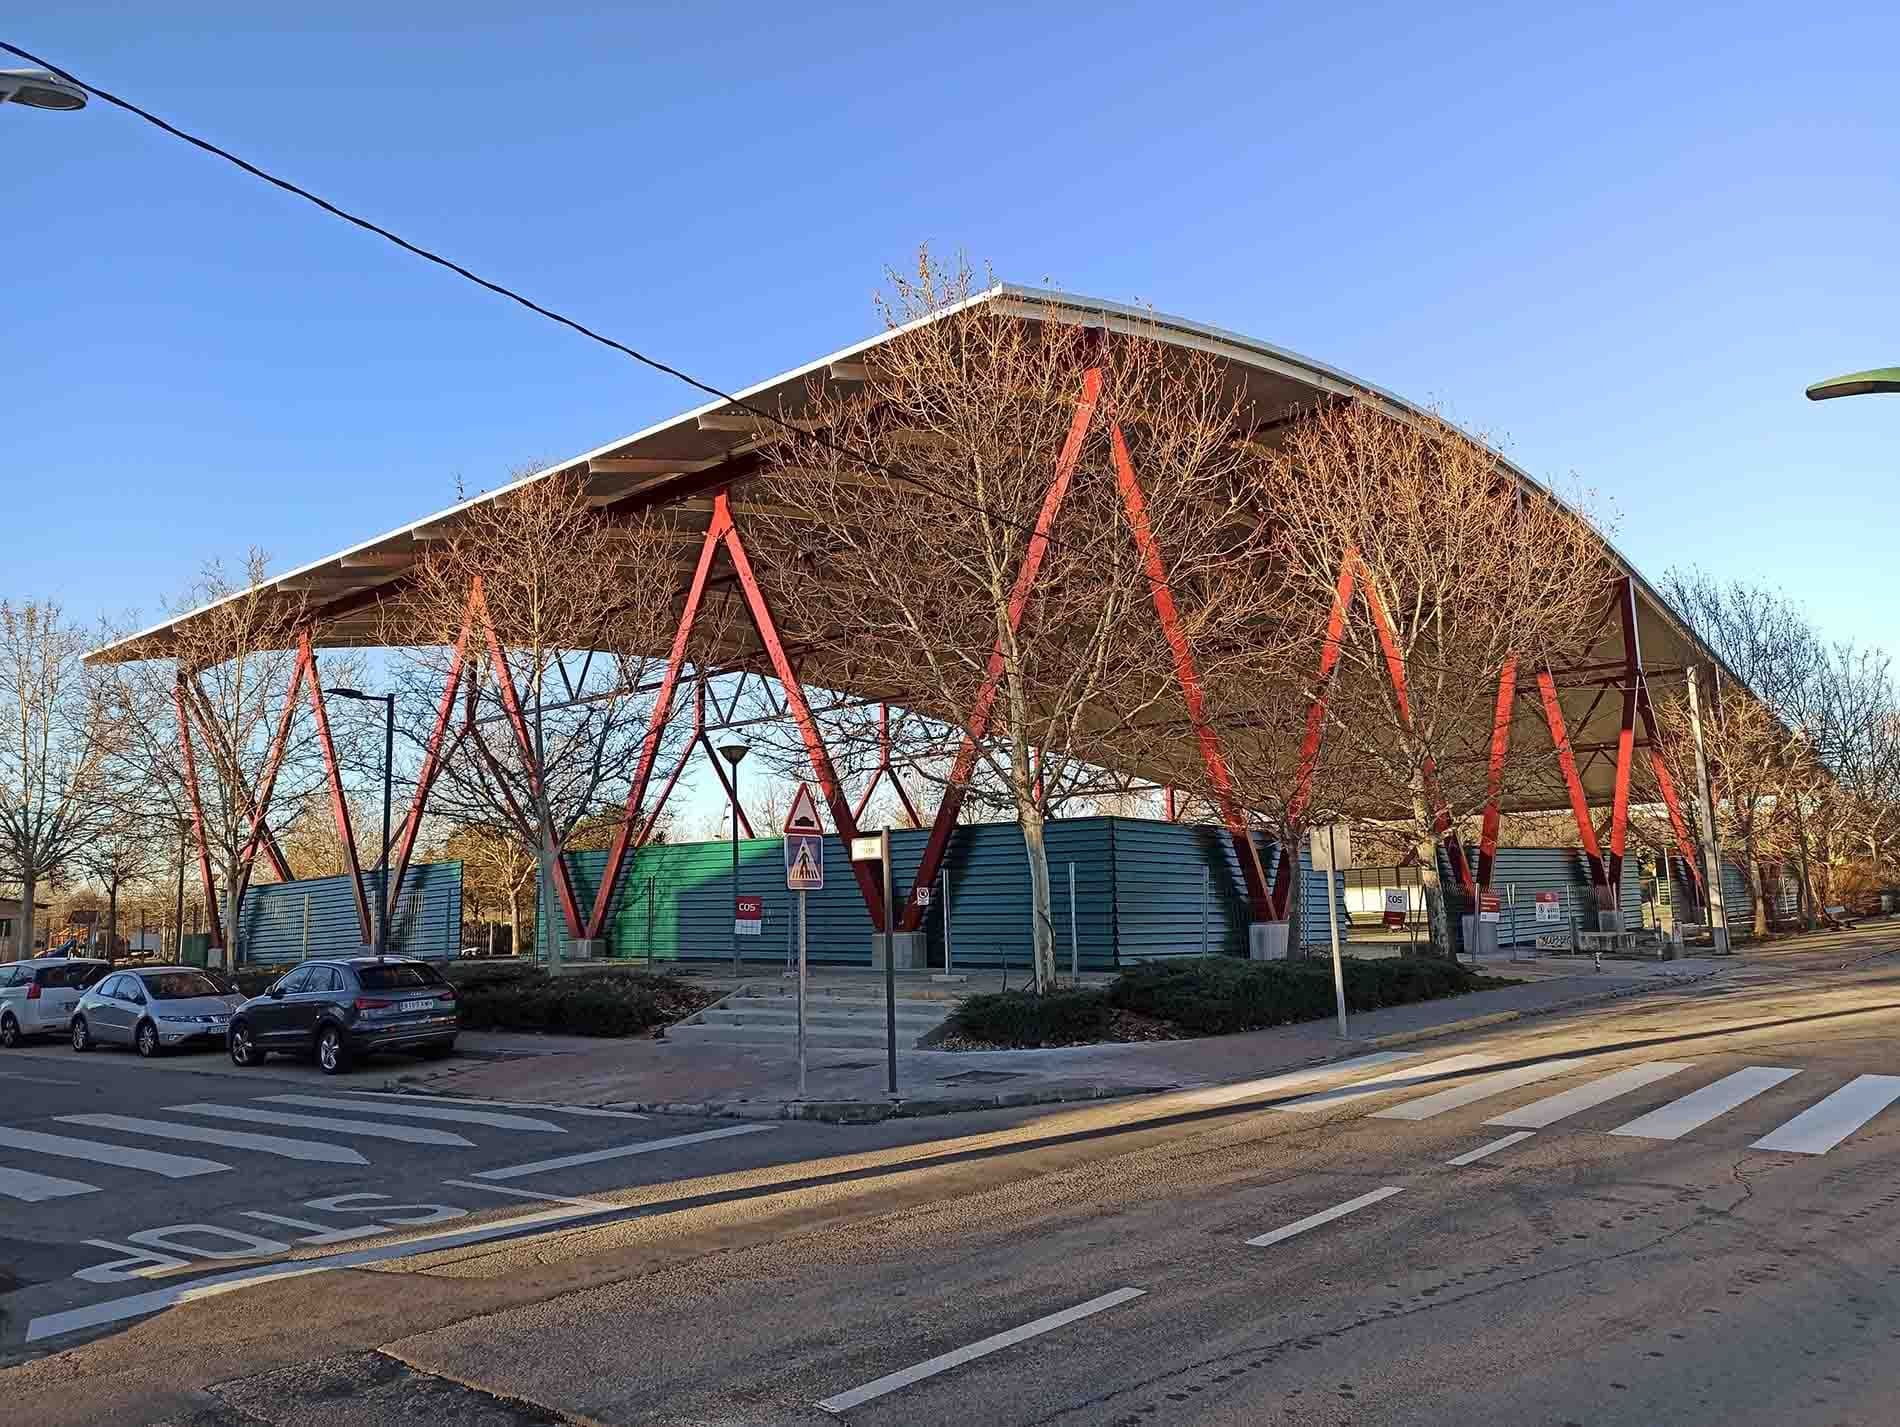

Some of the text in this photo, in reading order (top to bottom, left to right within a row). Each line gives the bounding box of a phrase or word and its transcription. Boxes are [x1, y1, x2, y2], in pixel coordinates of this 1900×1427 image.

[1387, 895, 1403, 904] COS
[738, 903, 756, 912] COS
[72, 1193, 469, 1282] STOP
